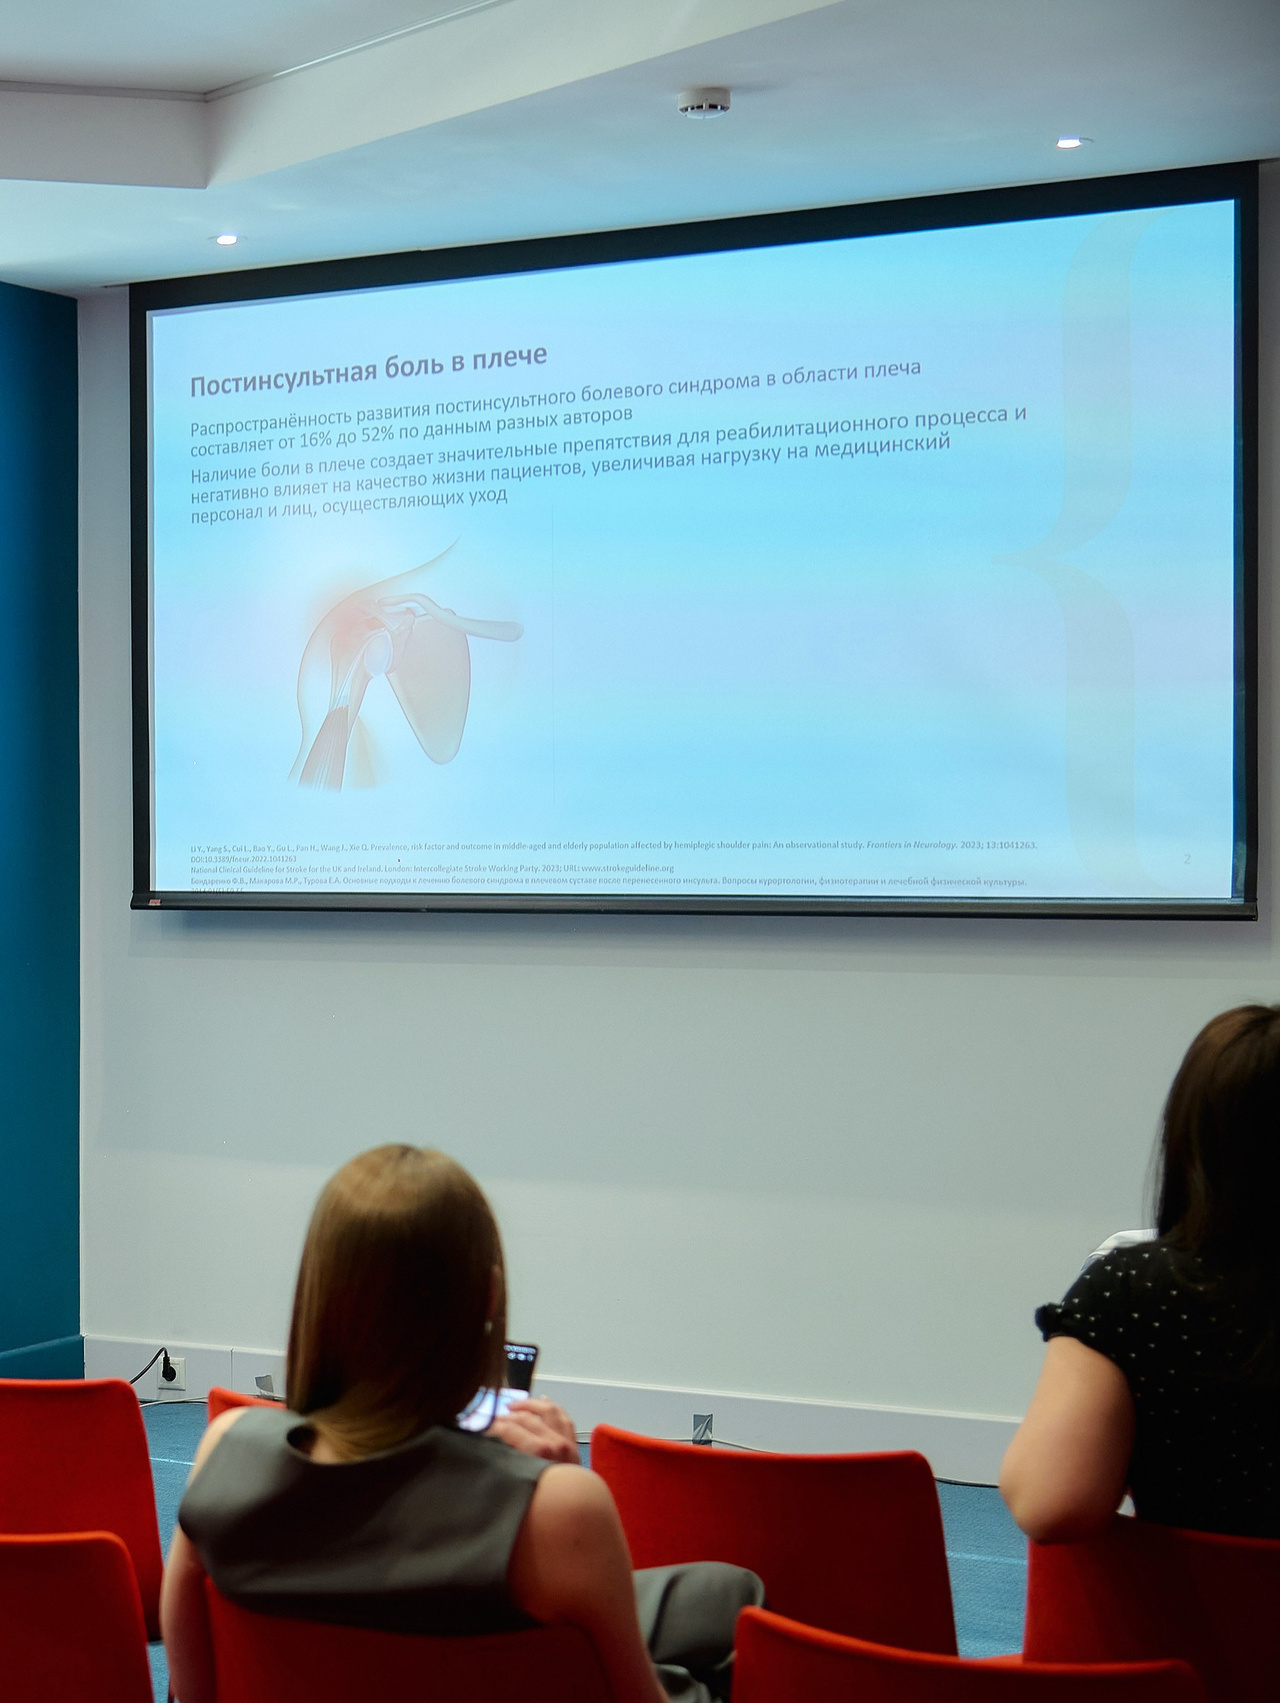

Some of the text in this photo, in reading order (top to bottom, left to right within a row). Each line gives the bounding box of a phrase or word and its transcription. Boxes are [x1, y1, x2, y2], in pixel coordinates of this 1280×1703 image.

[190, 346, 548, 398] Постинсультная боль в плече
[190, 361, 921, 438] Распространённость развития постинсультного болевого синдрома в области плеча
[190, 408, 633, 458] составляет от 16% до 52% по данным разных авторов
[191, 406, 1027, 485] Наличие боли в плече создает значительные препятствия для реабилитационного процесса и
[191, 430, 950, 505] негативно влияет на качество жизни пациентов, увеличивая нагрузку на медицинский
[191, 488, 508, 526] персонал и лиц, осуществляющих уход
[190, 866, 218, 874] National
[218, 866, 242, 874] Clinical
[242, 866, 274, 874] Guideline
[384, 865, 412, 873] London:
[413, 865, 463, 875] Intercollegiate
[487, 865, 518, 875] Working
[541, 864, 562, 874] 2023;
[562, 864, 580, 872] URL:
[580, 864, 674, 874] www.strokeguideline.org
[206, 845, 222, 855] Yang
[320, 844, 341, 854] Wang
[410, 843, 423, 851] risk
[424, 843, 445, 851] factor
[460, 842, 493, 850] outcome
[502, 842, 547, 852] middle-aged
[563, 842, 589, 852] elderly
[589, 842, 629, 852] population
[630, 841, 662, 849] affected
[674, 841, 716, 851] hemiplegic
[716, 841, 750, 849] shoulder
[751, 841, 772, 851] pain:
[785, 841, 840, 849] observational
[866, 841, 902, 849] Frontiers
[960, 841, 984, 851] 2023;
[1184, 853, 1192, 865] 2
[249, 877, 284, 887] Макарова
[303, 877, 328, 887] Турова
[342, 877, 378, 885] Основные
[379, 878, 411, 887] подходы
[486, 878, 524, 887] синдрома
[569, 878, 597, 887] суставе
[722, 877, 758, 887] Вопросы
[887, 877, 929, 885] лечебной
